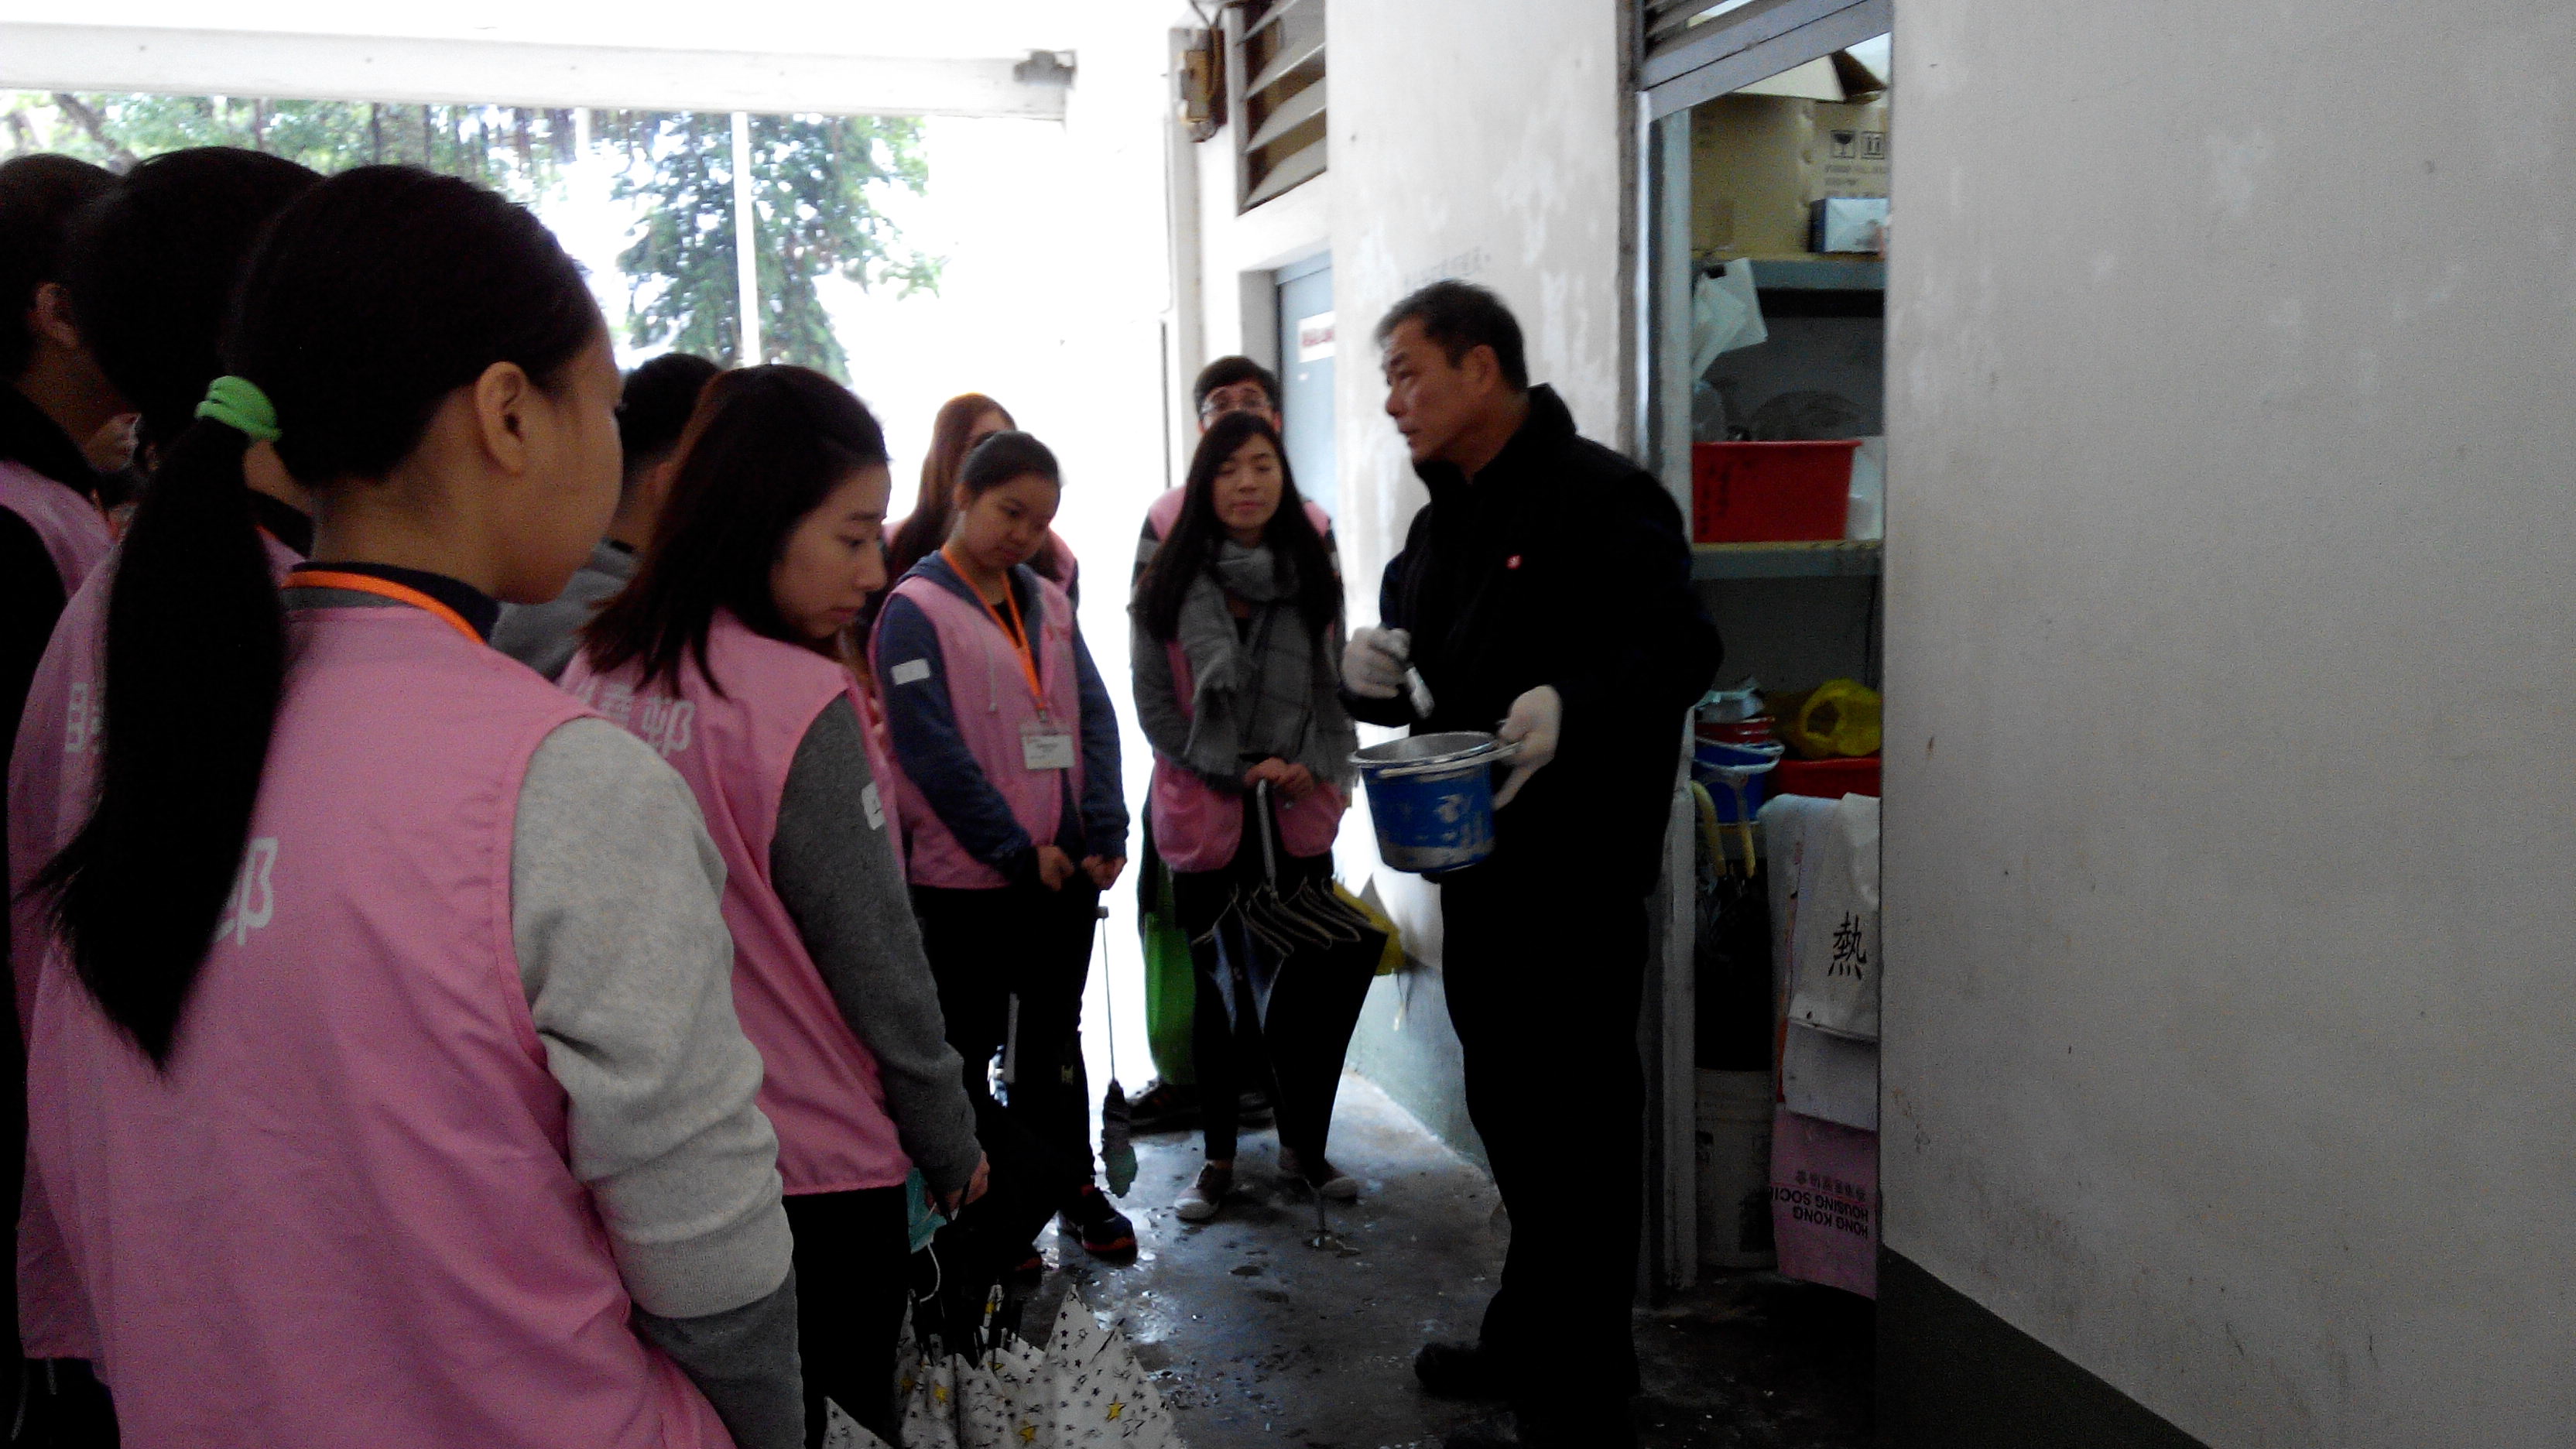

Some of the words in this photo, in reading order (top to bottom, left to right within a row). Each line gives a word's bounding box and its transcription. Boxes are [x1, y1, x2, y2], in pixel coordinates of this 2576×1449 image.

[1828, 911, 1867, 981] 熱
[1770, 1187, 1810, 1205] SOCI
[1793, 1206, 1832, 1227] KONG
[1815, 1194, 1869, 1222] HOUSING
[1835, 1216, 1869, 1238] HONG
